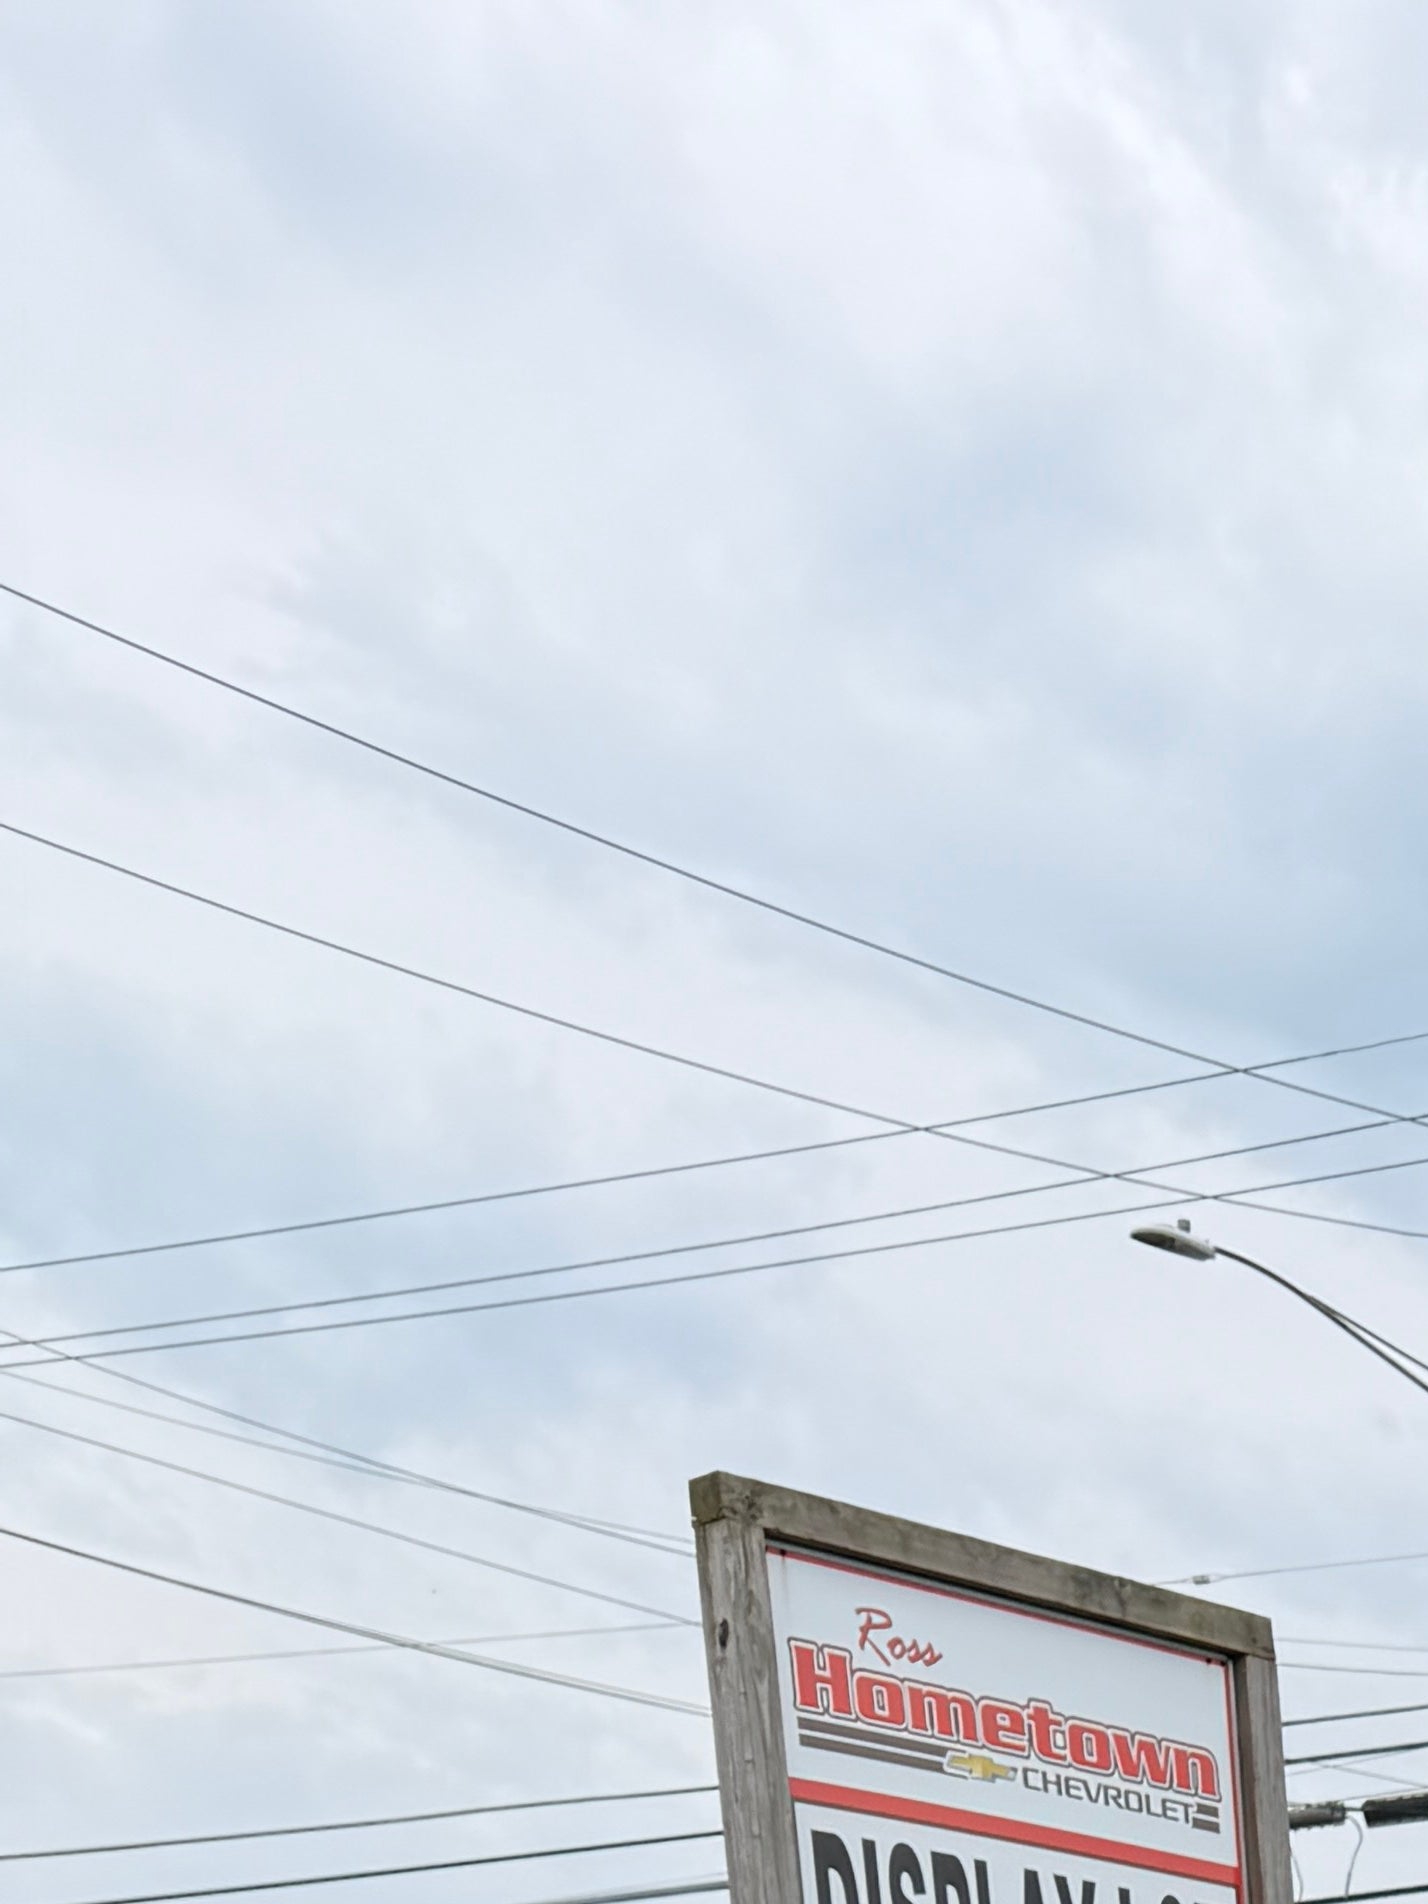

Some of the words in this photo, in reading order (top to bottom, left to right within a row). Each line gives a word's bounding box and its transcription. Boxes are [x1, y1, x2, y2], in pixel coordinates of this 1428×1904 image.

[855, 1607, 943, 1667] Ross
[787, 1636, 1221, 1801] Hometown
[1022, 1767, 1194, 1826] CHEVROLET
